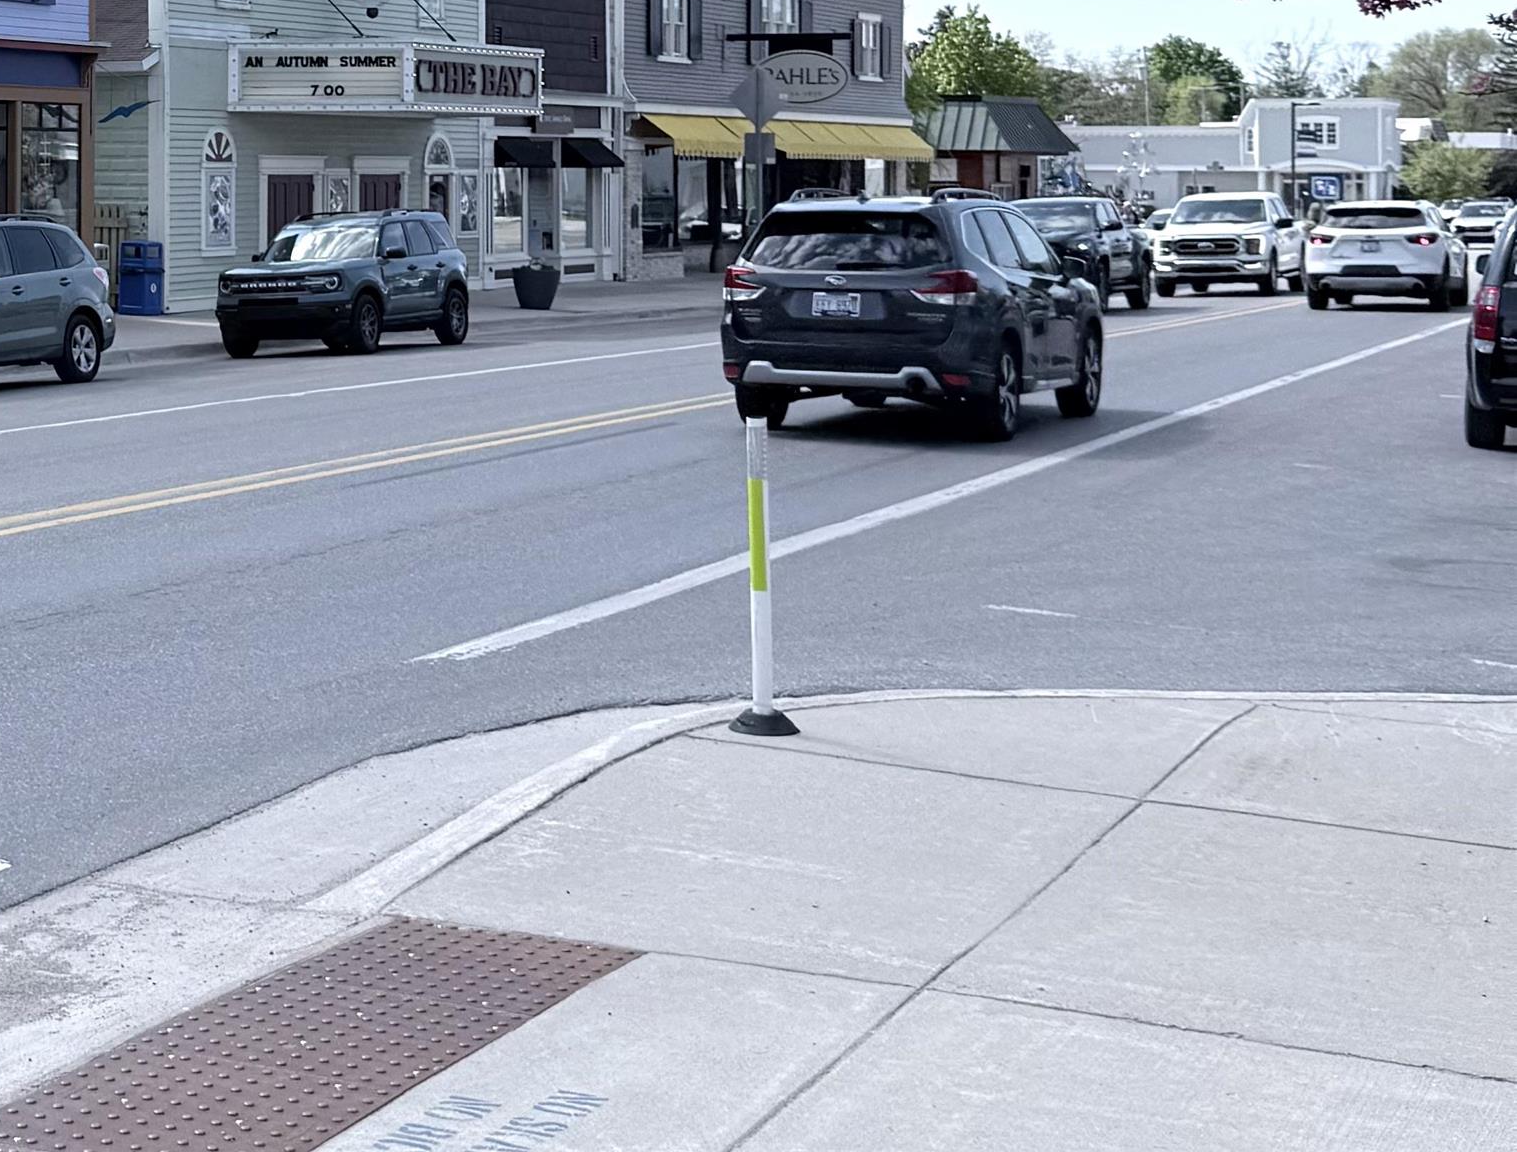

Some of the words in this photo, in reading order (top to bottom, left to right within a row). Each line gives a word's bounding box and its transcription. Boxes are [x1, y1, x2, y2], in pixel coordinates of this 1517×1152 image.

[244, 56, 264, 68] AN
[275, 56, 329, 68] AUTUMN
[339, 56, 397, 68] SUMMER
[427, 60, 477, 95] THE
[479, 64, 523, 98] BAY
